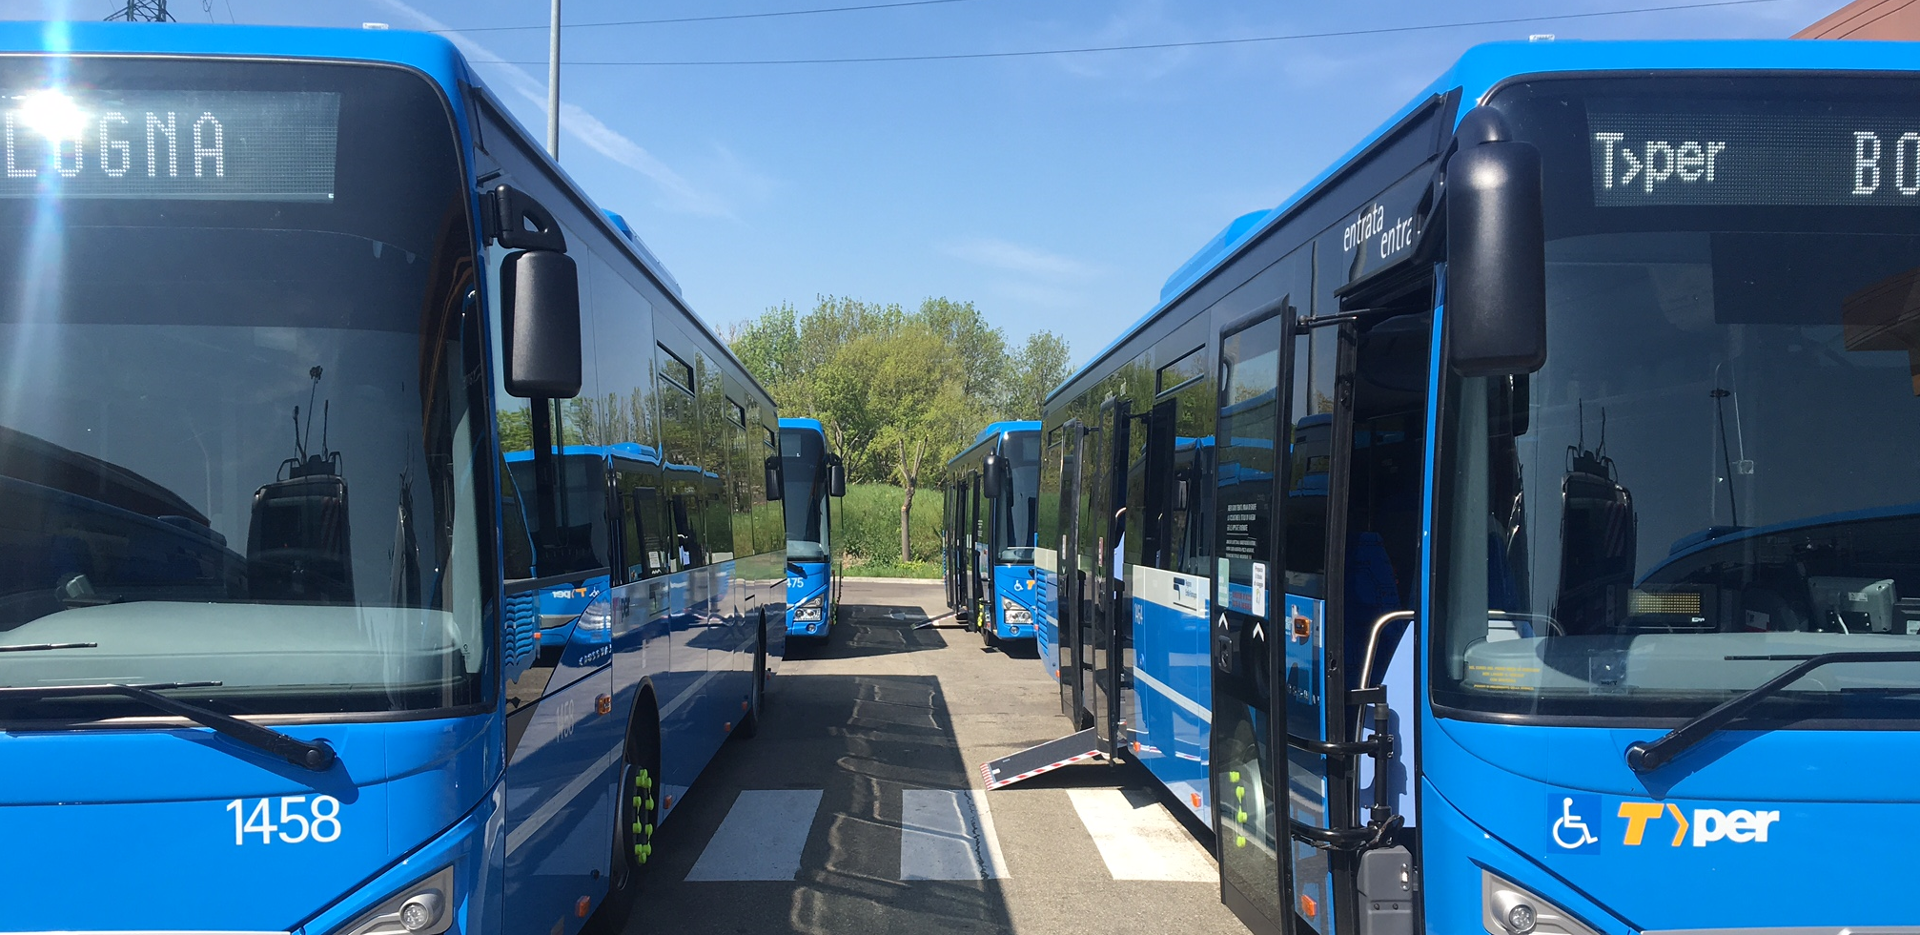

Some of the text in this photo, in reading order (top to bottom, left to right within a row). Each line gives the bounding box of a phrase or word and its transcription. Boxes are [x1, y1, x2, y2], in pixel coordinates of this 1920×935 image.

[1852, 131, 1920, 195] BO
[1343, 203, 1384, 252] entrata
[556, 698, 575, 743] 1458
[226, 795, 341, 846] 1458
